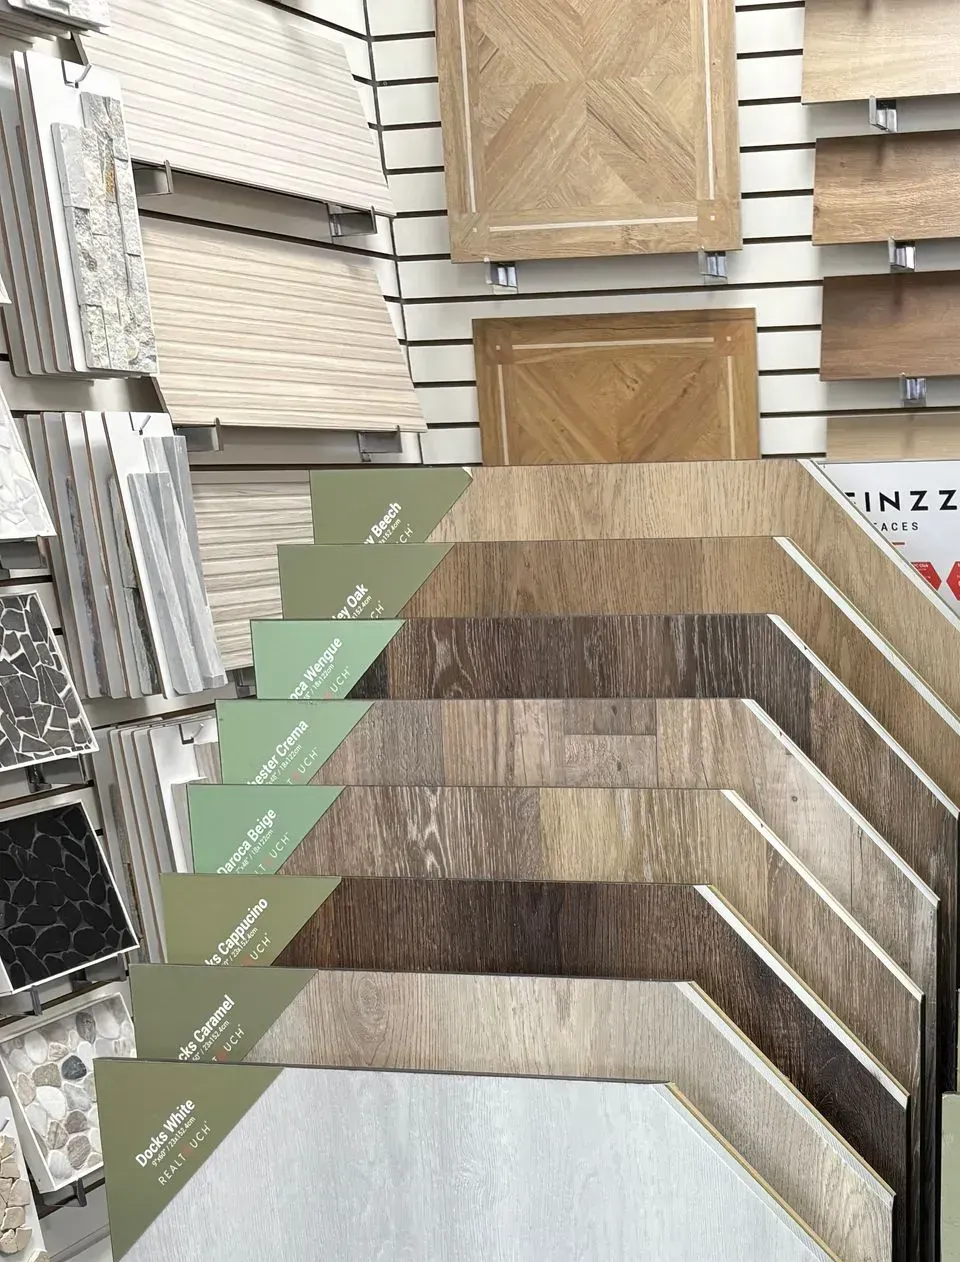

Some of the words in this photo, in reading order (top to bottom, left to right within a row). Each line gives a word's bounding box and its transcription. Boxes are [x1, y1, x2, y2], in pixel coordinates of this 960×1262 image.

[371, 502, 402, 538] Beech
[346, 583, 369, 608] Oak
[303, 637, 343, 682] Wengue
[276, 720, 309, 757] Crema
[246, 809, 277, 843] Beige
[217, 898, 268, 955] Cappucino
[193, 993, 235, 1043] Caramel
[135, 1131, 169, 1168] Docks
[162, 1099, 196, 1133] White
[168, 1116, 196, 1148] 23x152.4cm
